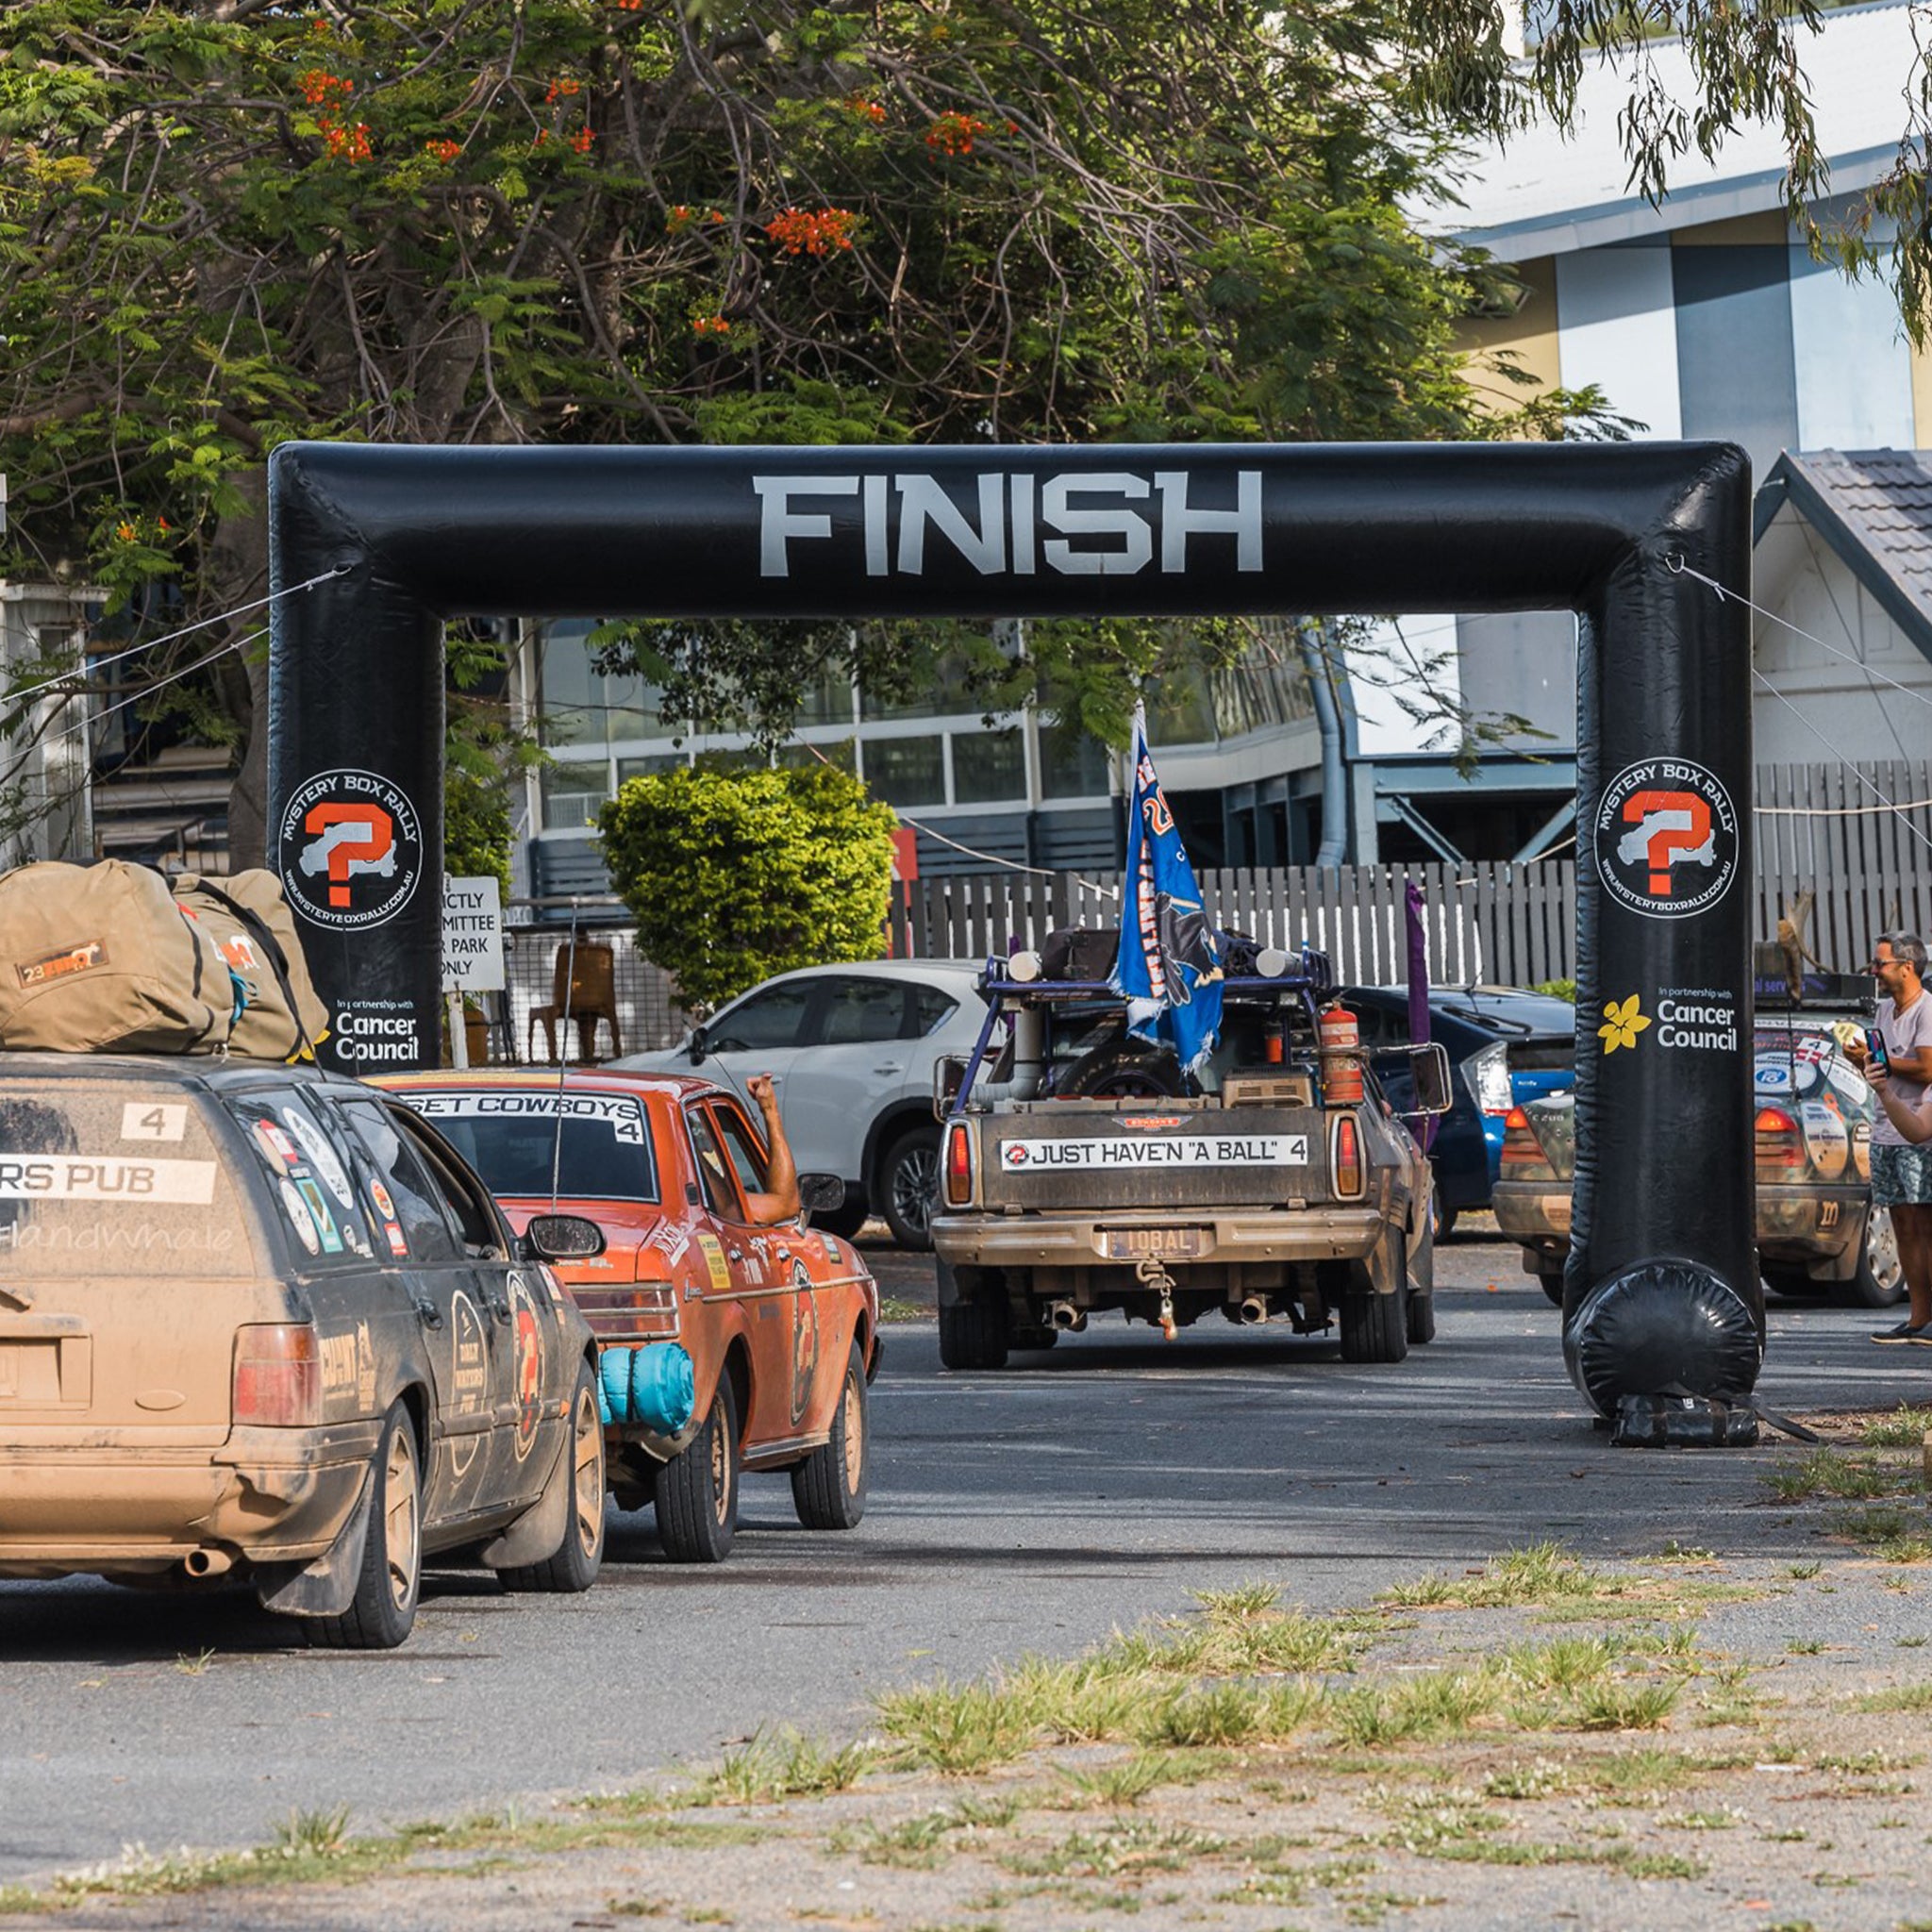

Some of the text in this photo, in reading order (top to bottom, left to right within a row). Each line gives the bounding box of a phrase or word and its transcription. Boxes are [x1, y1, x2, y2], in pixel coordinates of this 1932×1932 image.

[753, 471, 1263, 577] FINISH
[283, 775, 417, 842] MYSTERY BOX RALLY
[1599, 763, 1734, 834] MYSTERY BOX RALLY
[1602, 858, 1732, 911] WWW.MYSTERYBOXRALLY.COM.AU
[451, 938, 489, 954] PARK
[398, 1000, 414, 1008] with
[1658, 987, 1733, 1000] In partnership with
[336, 1011, 417, 1036] Cancer
[1657, 999, 1735, 1025] Cancer
[335, 1037, 419, 1060] Council
[1657, 1024, 1737, 1052] Council
[1807, 1041, 1821, 1051] 4
[477, 1097, 641, 1121] COWBOYS
[140, 1108, 166, 1136] 4
[617, 1124, 641, 1141] 4
[1032, 1144, 1095, 1164] JUST
[1189, 1141, 1210, 1161] "A
[1216, 1141, 1278, 1161] BALL"
[1291, 1139, 1306, 1160] 4
[66, 1164, 155, 1194] PUB
